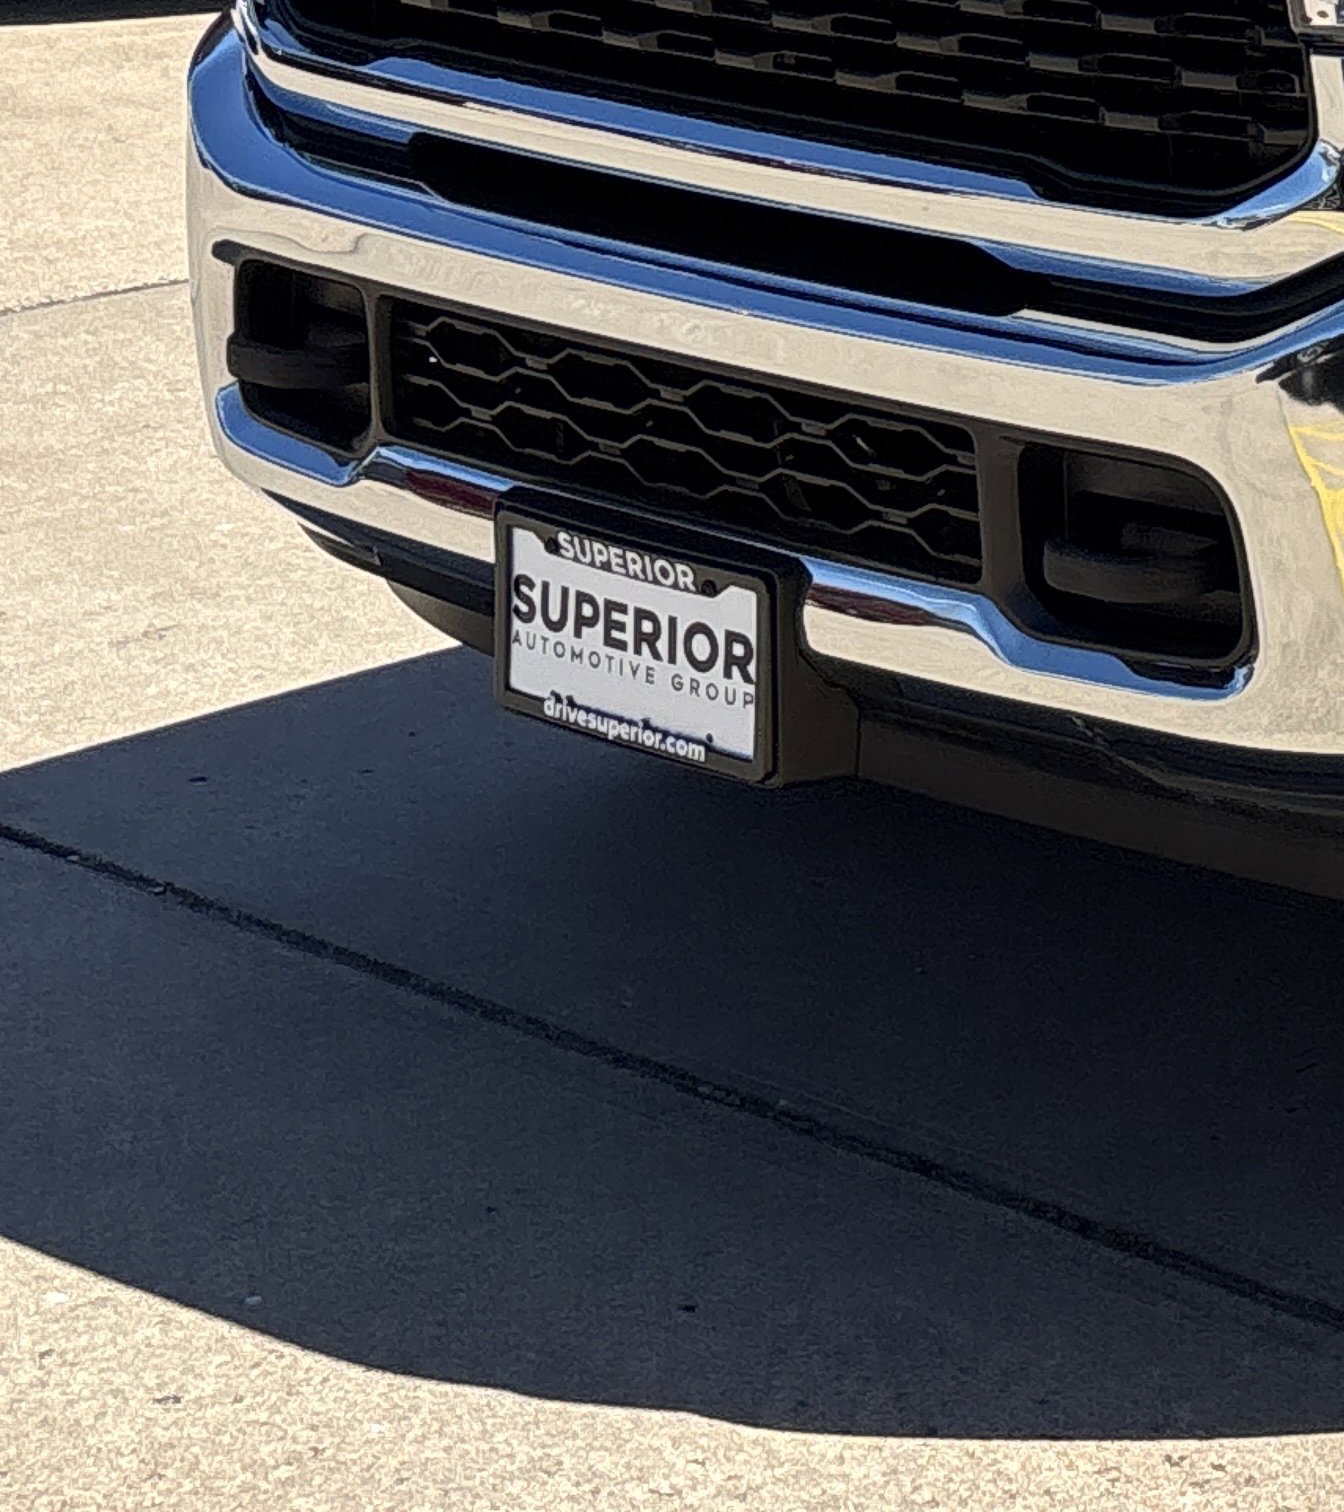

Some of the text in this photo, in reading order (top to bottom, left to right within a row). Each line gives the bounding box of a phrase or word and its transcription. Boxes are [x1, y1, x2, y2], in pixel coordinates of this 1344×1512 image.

[556, 530, 698, 592] SUPERIOR
[512, 573, 757, 686] SUPERIOR
[511, 627, 757, 710] AUTOMOTIVE GROUP
[542, 694, 707, 764] drivesuperior.com
